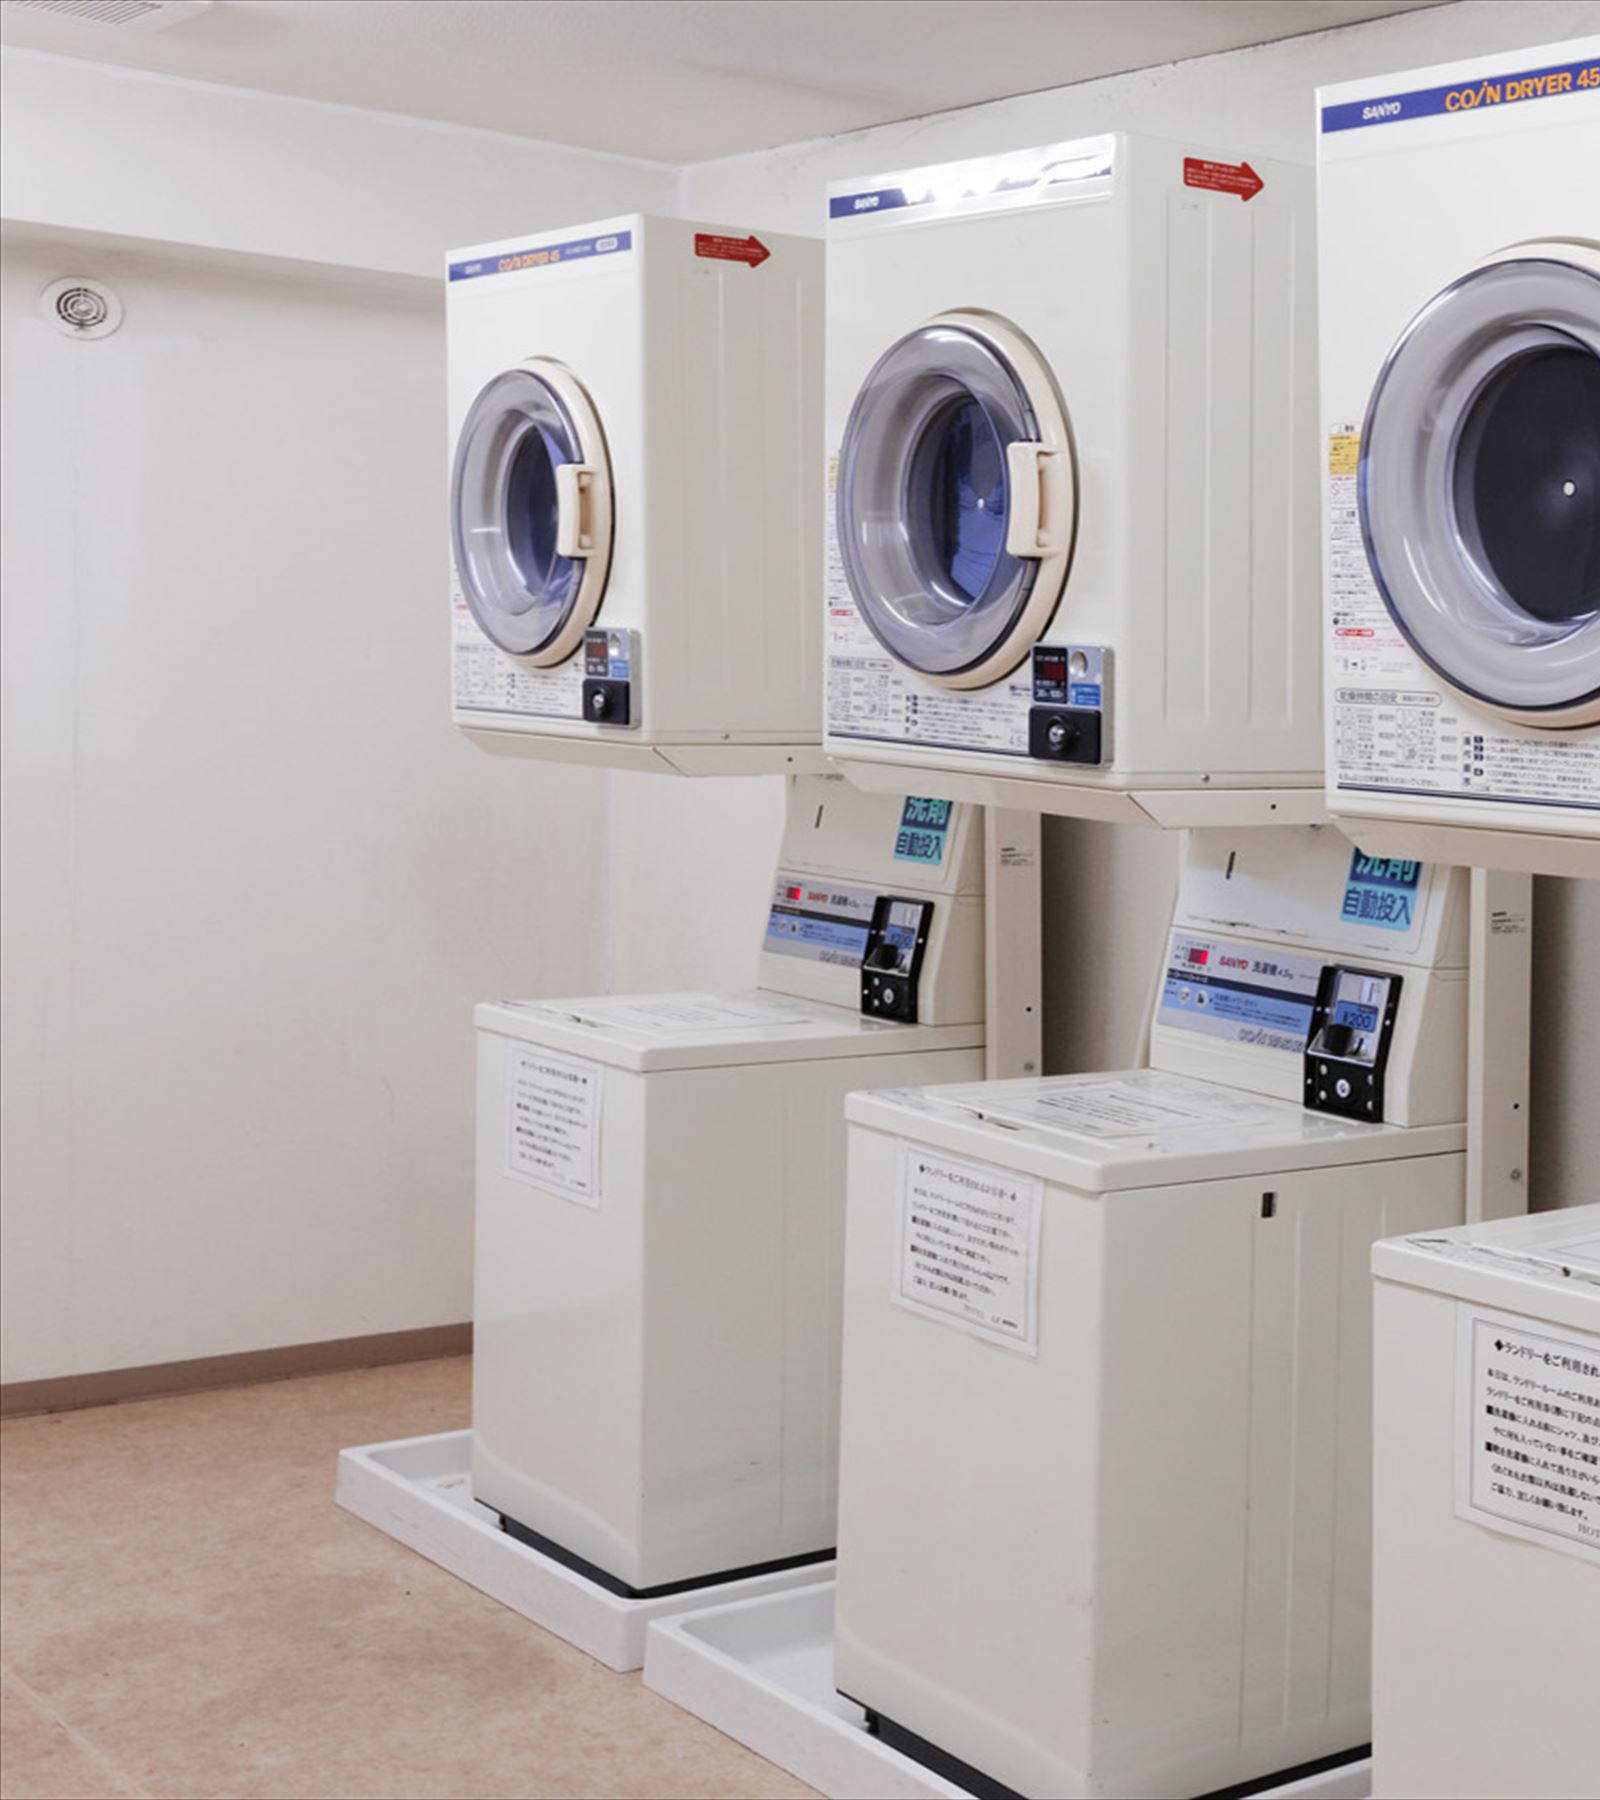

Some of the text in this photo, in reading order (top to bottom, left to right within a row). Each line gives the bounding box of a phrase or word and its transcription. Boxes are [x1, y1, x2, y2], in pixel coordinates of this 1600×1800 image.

[1505, 71, 1572, 101] DRYER
[1576, 66, 1600, 88] 45
[1362, 101, 1402, 120] SANYO
[894, 831, 942, 862] 自動投入
[1342, 886, 1411, 926] 自動投入
